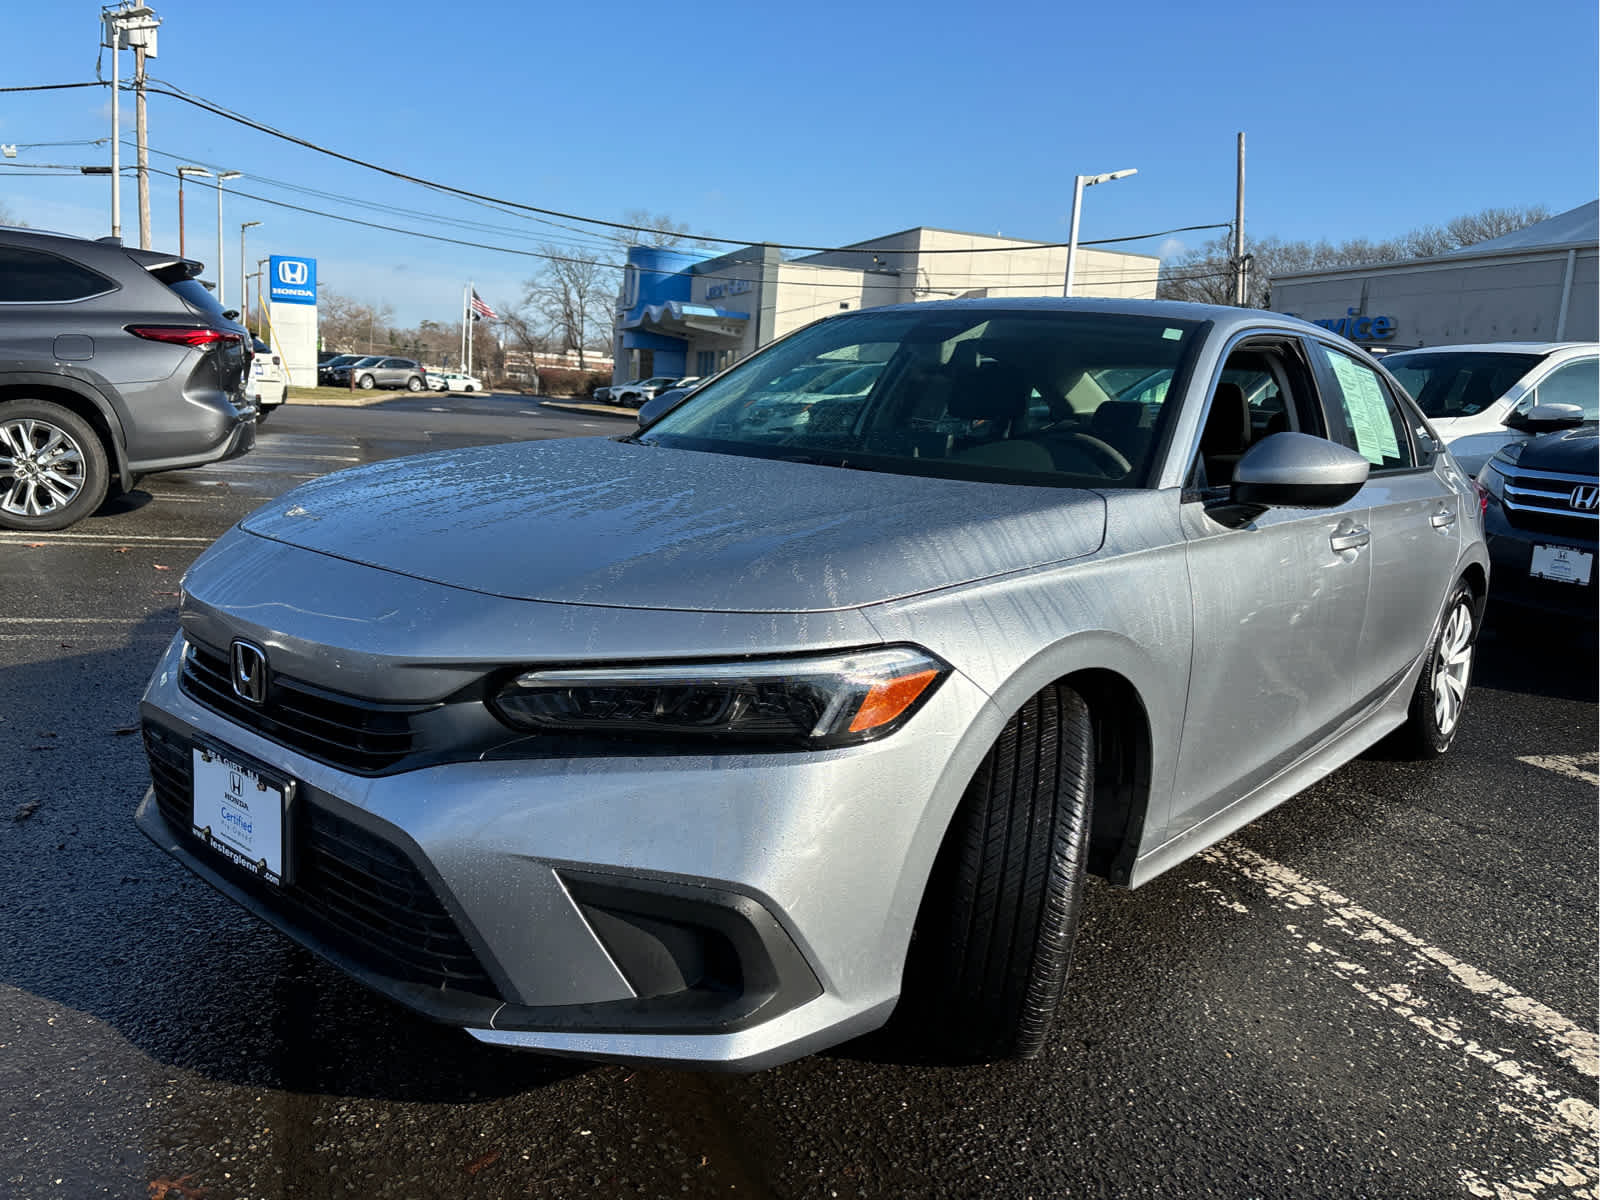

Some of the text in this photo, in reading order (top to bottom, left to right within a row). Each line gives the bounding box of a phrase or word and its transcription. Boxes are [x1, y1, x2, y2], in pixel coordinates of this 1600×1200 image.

[272, 288, 314, 297] HONDA
[224, 792, 249, 811] HONDA
[221, 807, 253, 834] Certified
[210, 838, 258, 874] lesterglenn
[264, 872, 280, 887] .com
